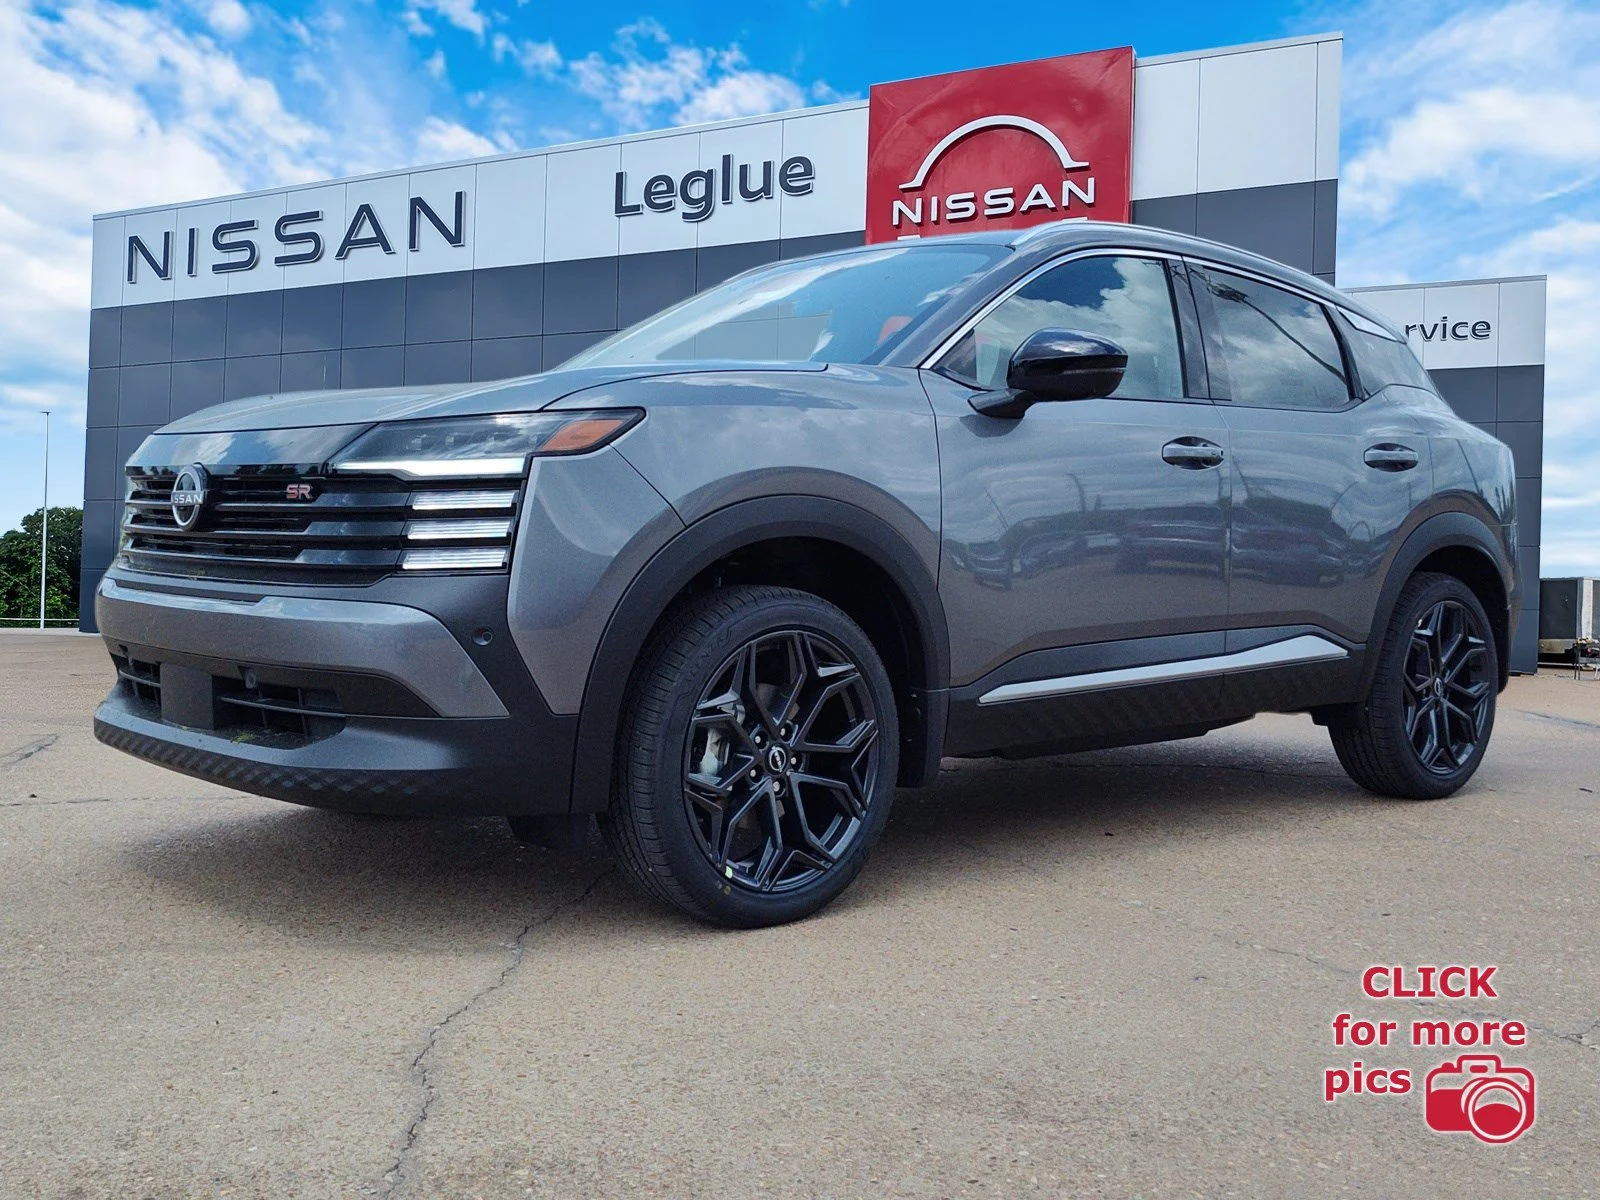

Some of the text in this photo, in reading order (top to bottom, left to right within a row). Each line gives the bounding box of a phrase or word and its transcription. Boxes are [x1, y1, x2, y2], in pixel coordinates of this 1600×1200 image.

[614, 154, 814, 222] Leglue
[892, 177, 1096, 226] NISSAN
[127, 190, 466, 284] NISSAN
[1405, 316, 1491, 342] rvice
[172, 493, 203, 504] SSAN
[286, 484, 313, 499] SR
